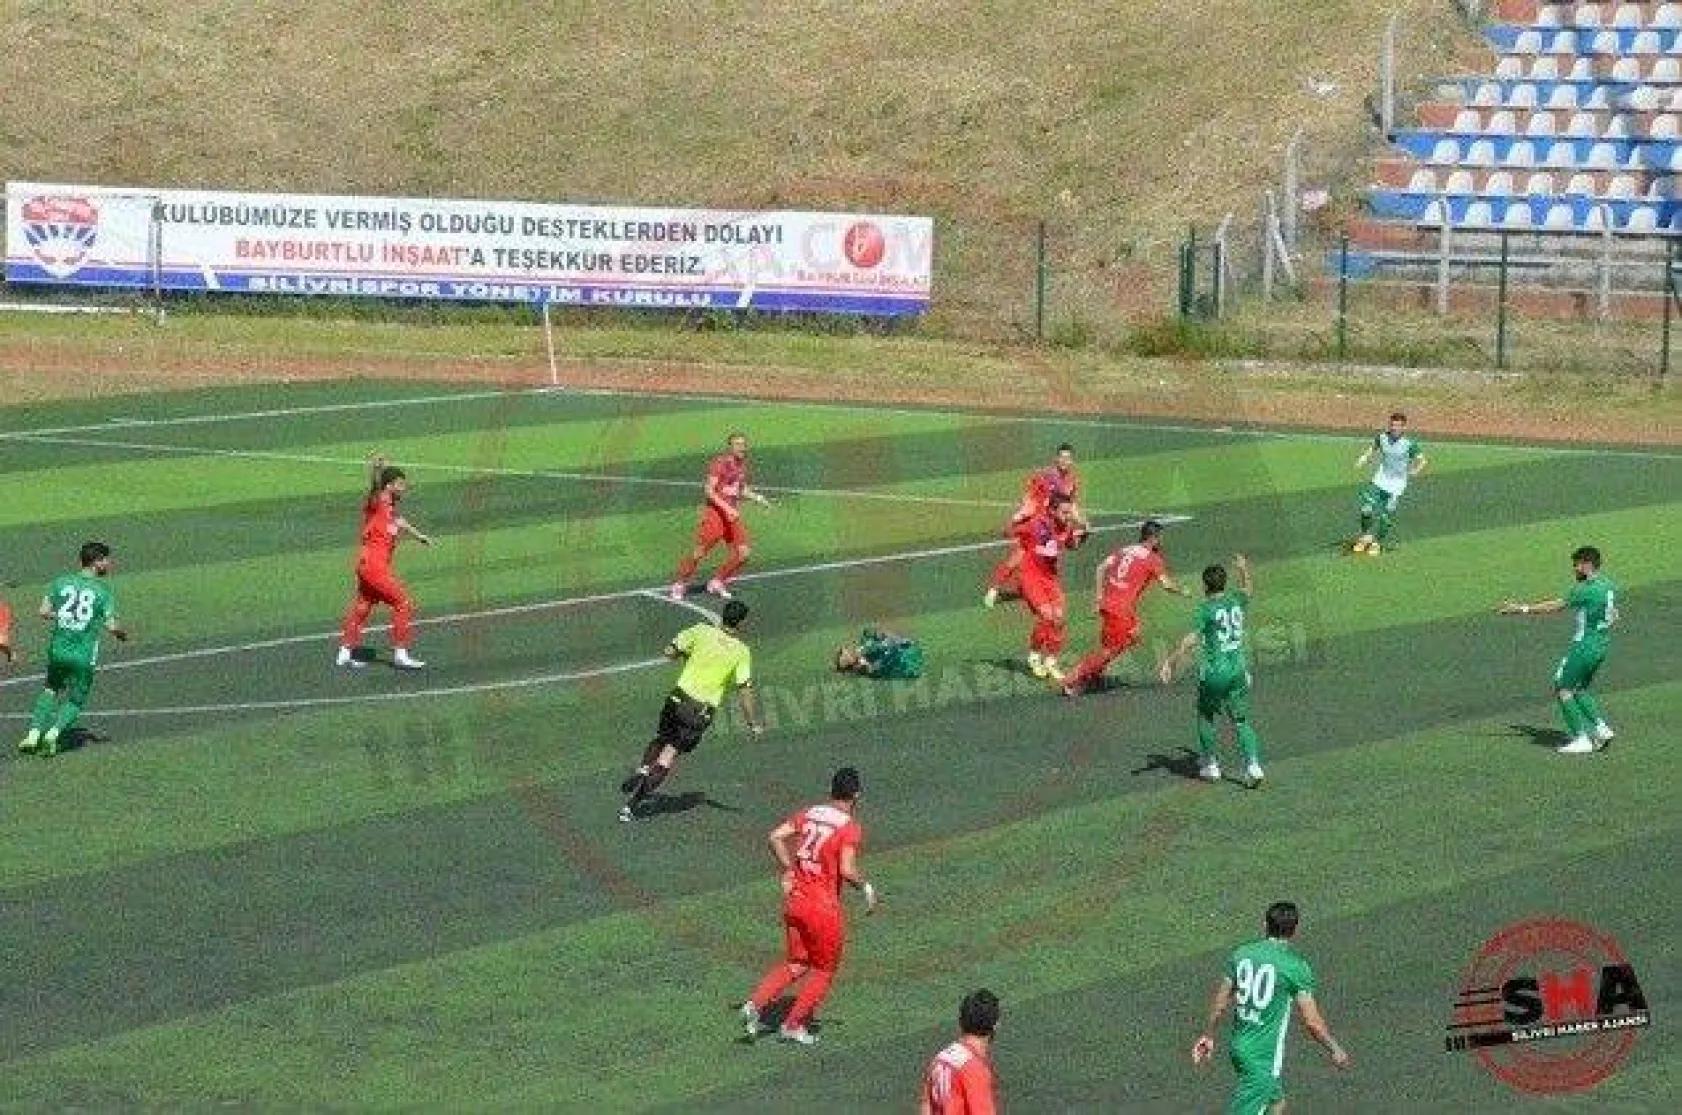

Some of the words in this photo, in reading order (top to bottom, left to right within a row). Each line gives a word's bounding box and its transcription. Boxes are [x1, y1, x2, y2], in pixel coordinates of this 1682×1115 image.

[156, 201, 316, 228] KULÜBÜMÜZE
[326, 206, 411, 236] VERMİŞ
[420, 211, 514, 234] OLDUĞU
[522, 216, 697, 242] DESTEKLERDEN
[704, 222, 783, 244] DOLAYI
[235, 238, 374, 263] BAYBURTLU
[382, 239, 485, 267] İNŞAAT'A
[58, 584, 97, 622] 28
[1215, 606, 1243, 640] 39
[797, 821, 835, 861] 27
[1236, 958, 1274, 1009] 90
